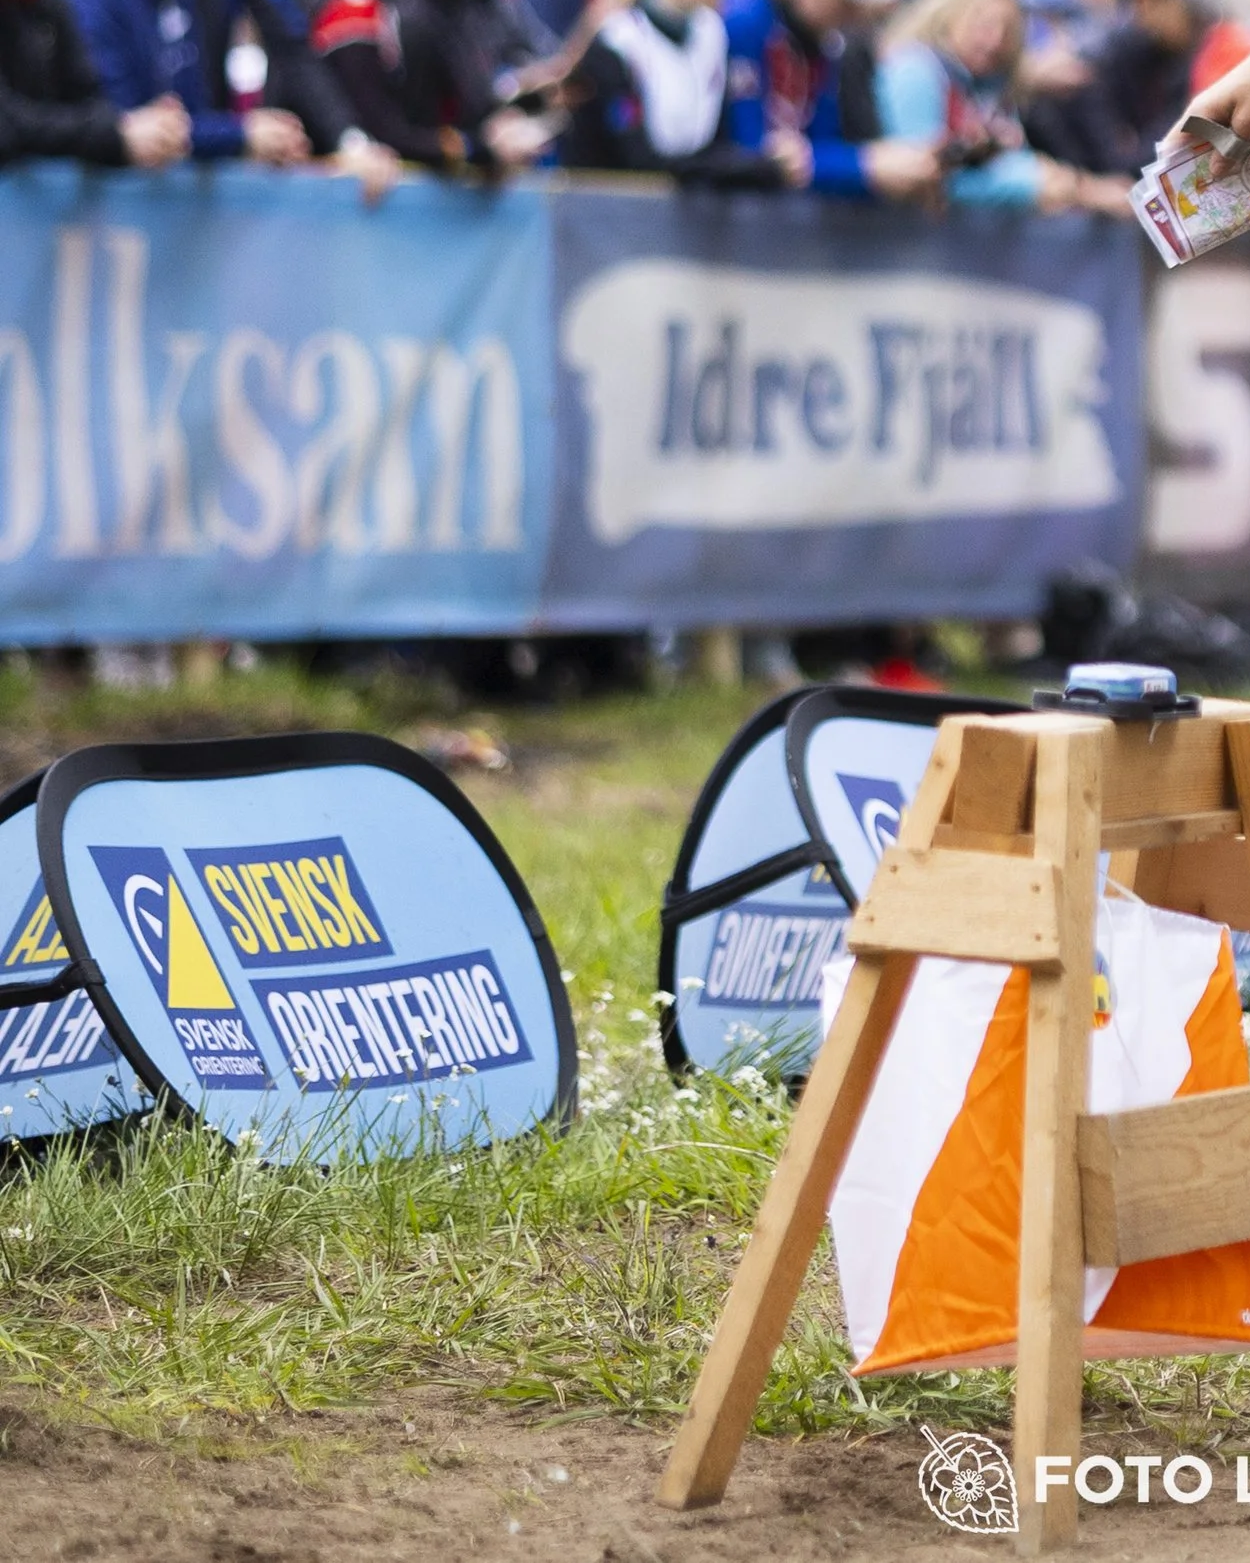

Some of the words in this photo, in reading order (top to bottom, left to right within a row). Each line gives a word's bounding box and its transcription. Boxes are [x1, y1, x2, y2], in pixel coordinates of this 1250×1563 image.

[657, 318, 853, 460] Idre
[867, 318, 1046, 490] Fjäll
[206, 854, 381, 956] SVENSK
[174, 1017, 256, 1051] SVENSK
[191, 1056, 265, 1076] ORIENTERING
[268, 964, 519, 1085] ORIENTERING
